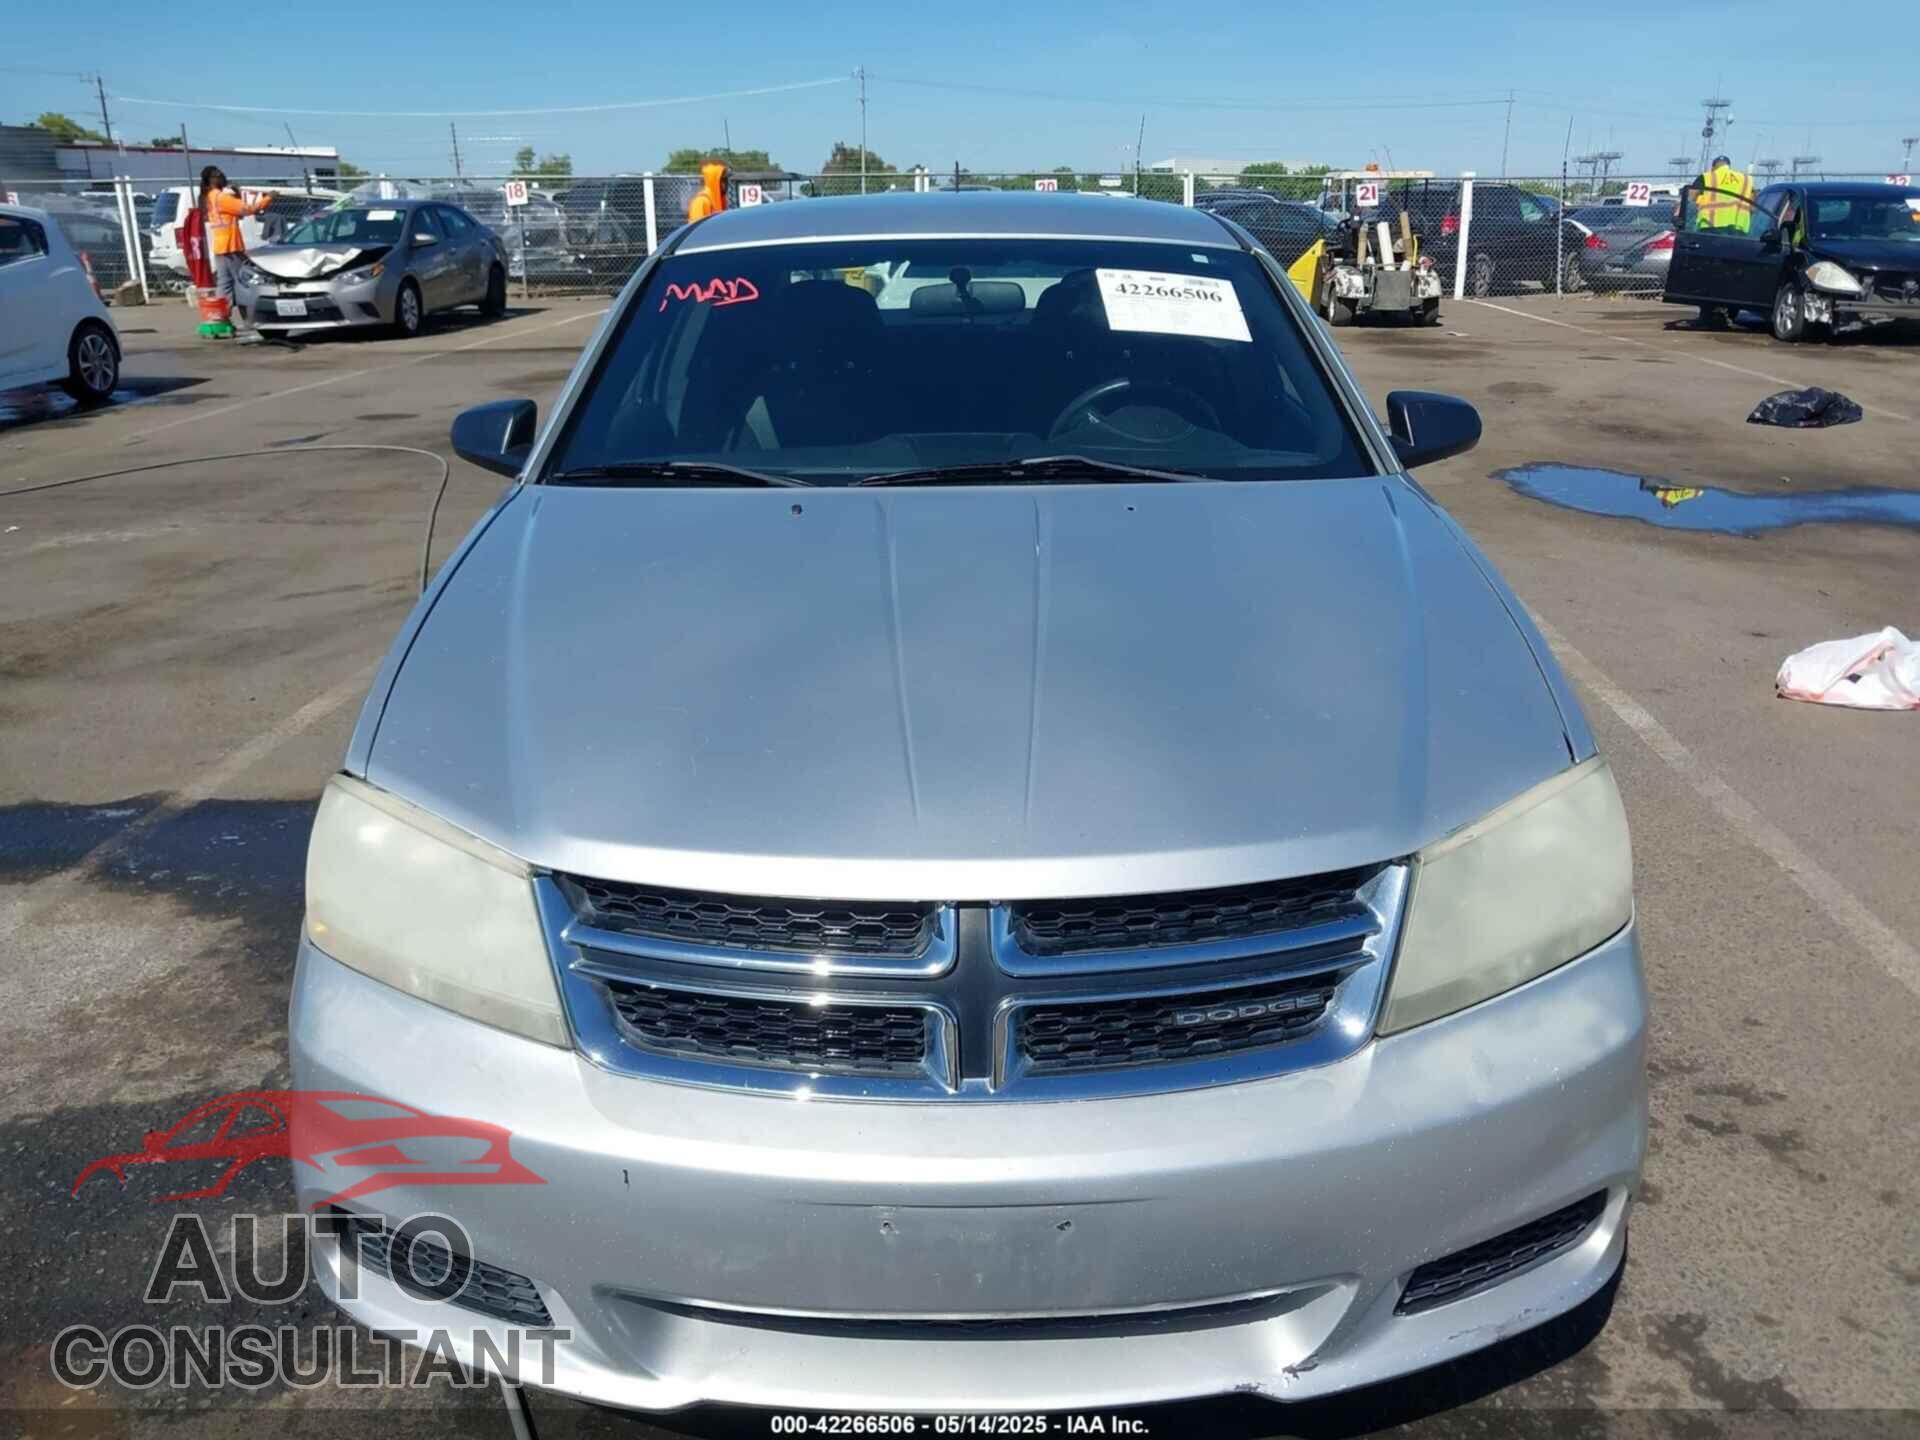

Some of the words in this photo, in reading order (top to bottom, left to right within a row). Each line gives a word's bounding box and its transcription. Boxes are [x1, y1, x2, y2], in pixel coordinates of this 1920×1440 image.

[508, 183, 524, 199] 18
[742, 187, 759, 202] 19
[1039, 181, 1056, 192] 20
[1359, 185, 1376, 200] 21
[1630, 184, 1649, 200] 22
[1115, 282, 1223, 303] 42266506
[1176, 993, 1322, 1025] DODGE
